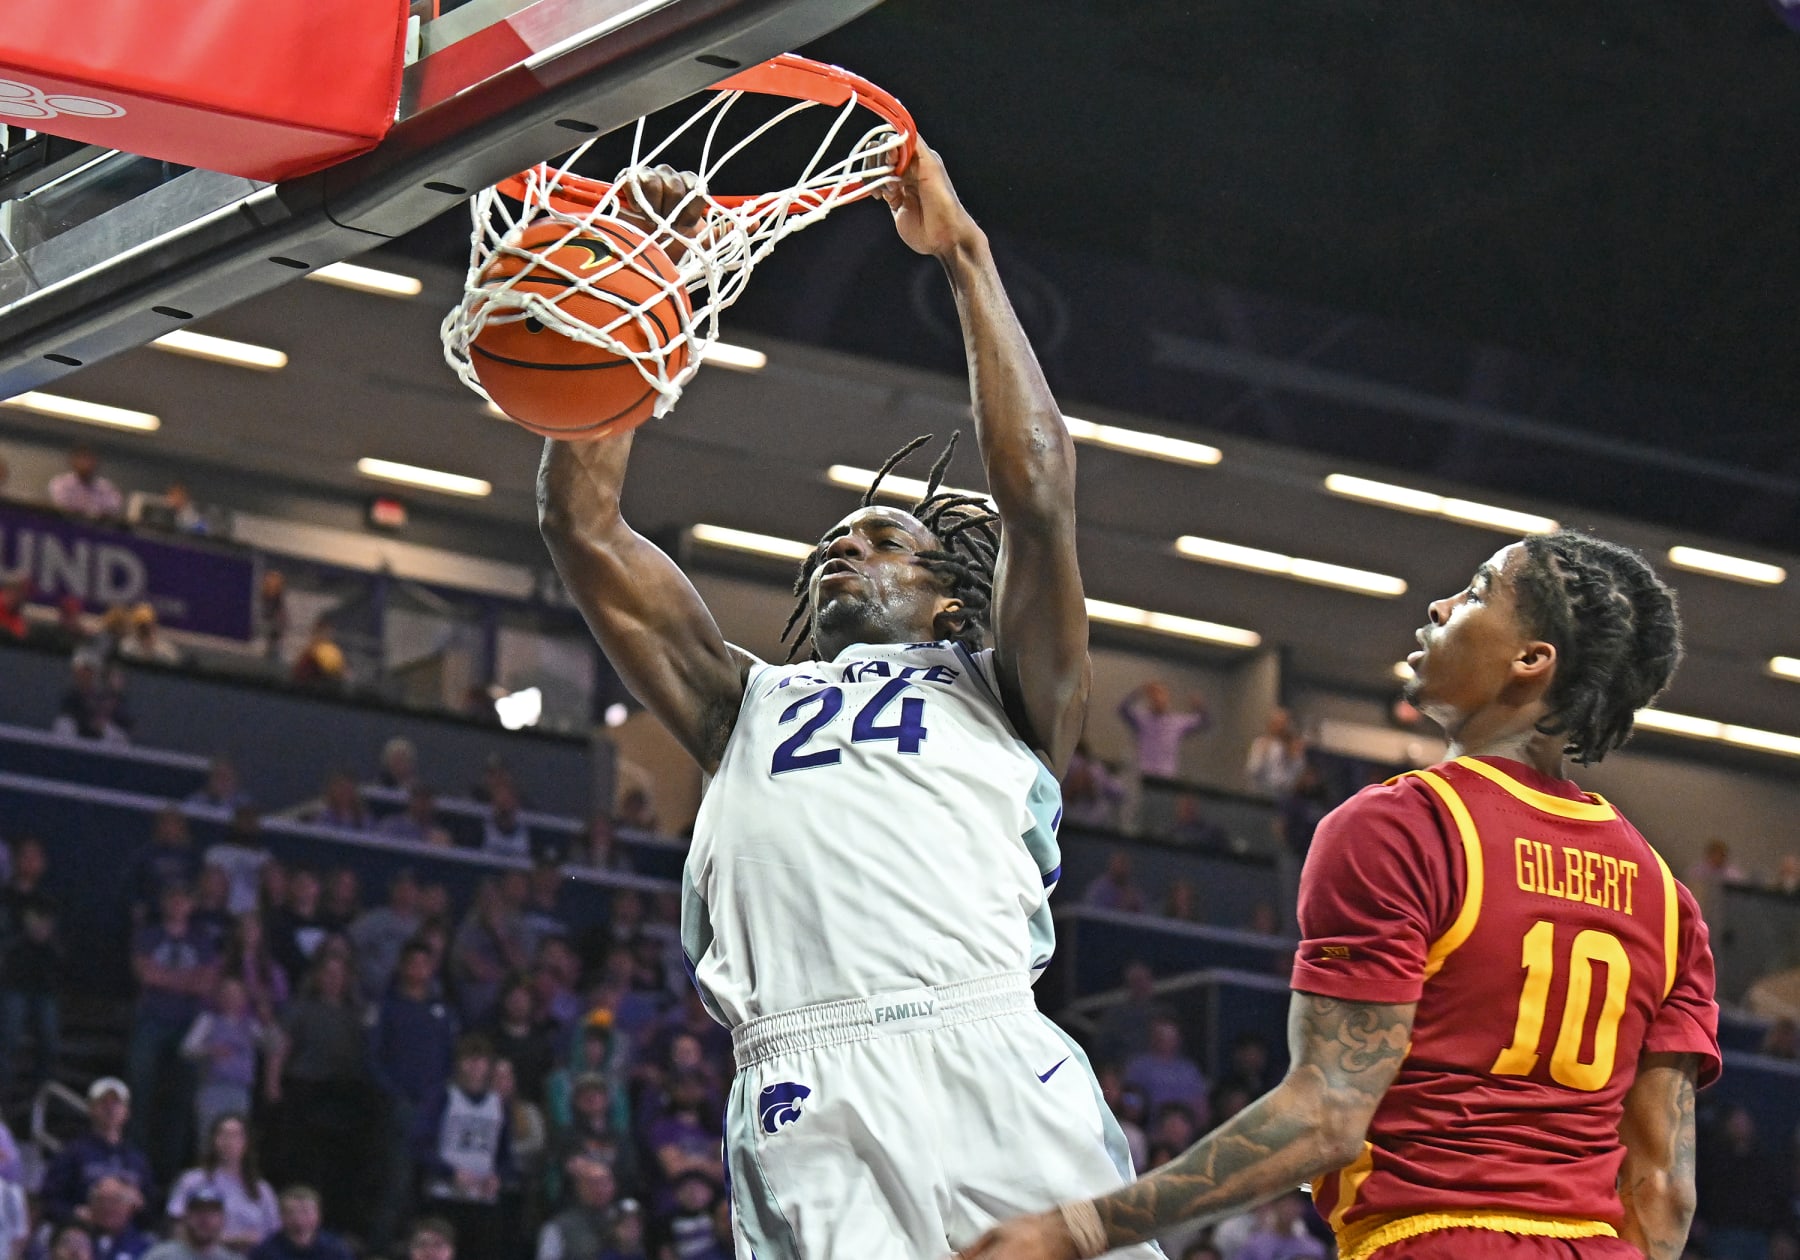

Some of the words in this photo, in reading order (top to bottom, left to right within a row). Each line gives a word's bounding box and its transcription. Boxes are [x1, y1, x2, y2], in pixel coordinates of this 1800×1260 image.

[769, 677, 928, 776] 24
[1514, 837, 1639, 916] GILBERT
[875, 1000, 934, 1024] FAMILY
[1490, 920, 1631, 1092] 10
